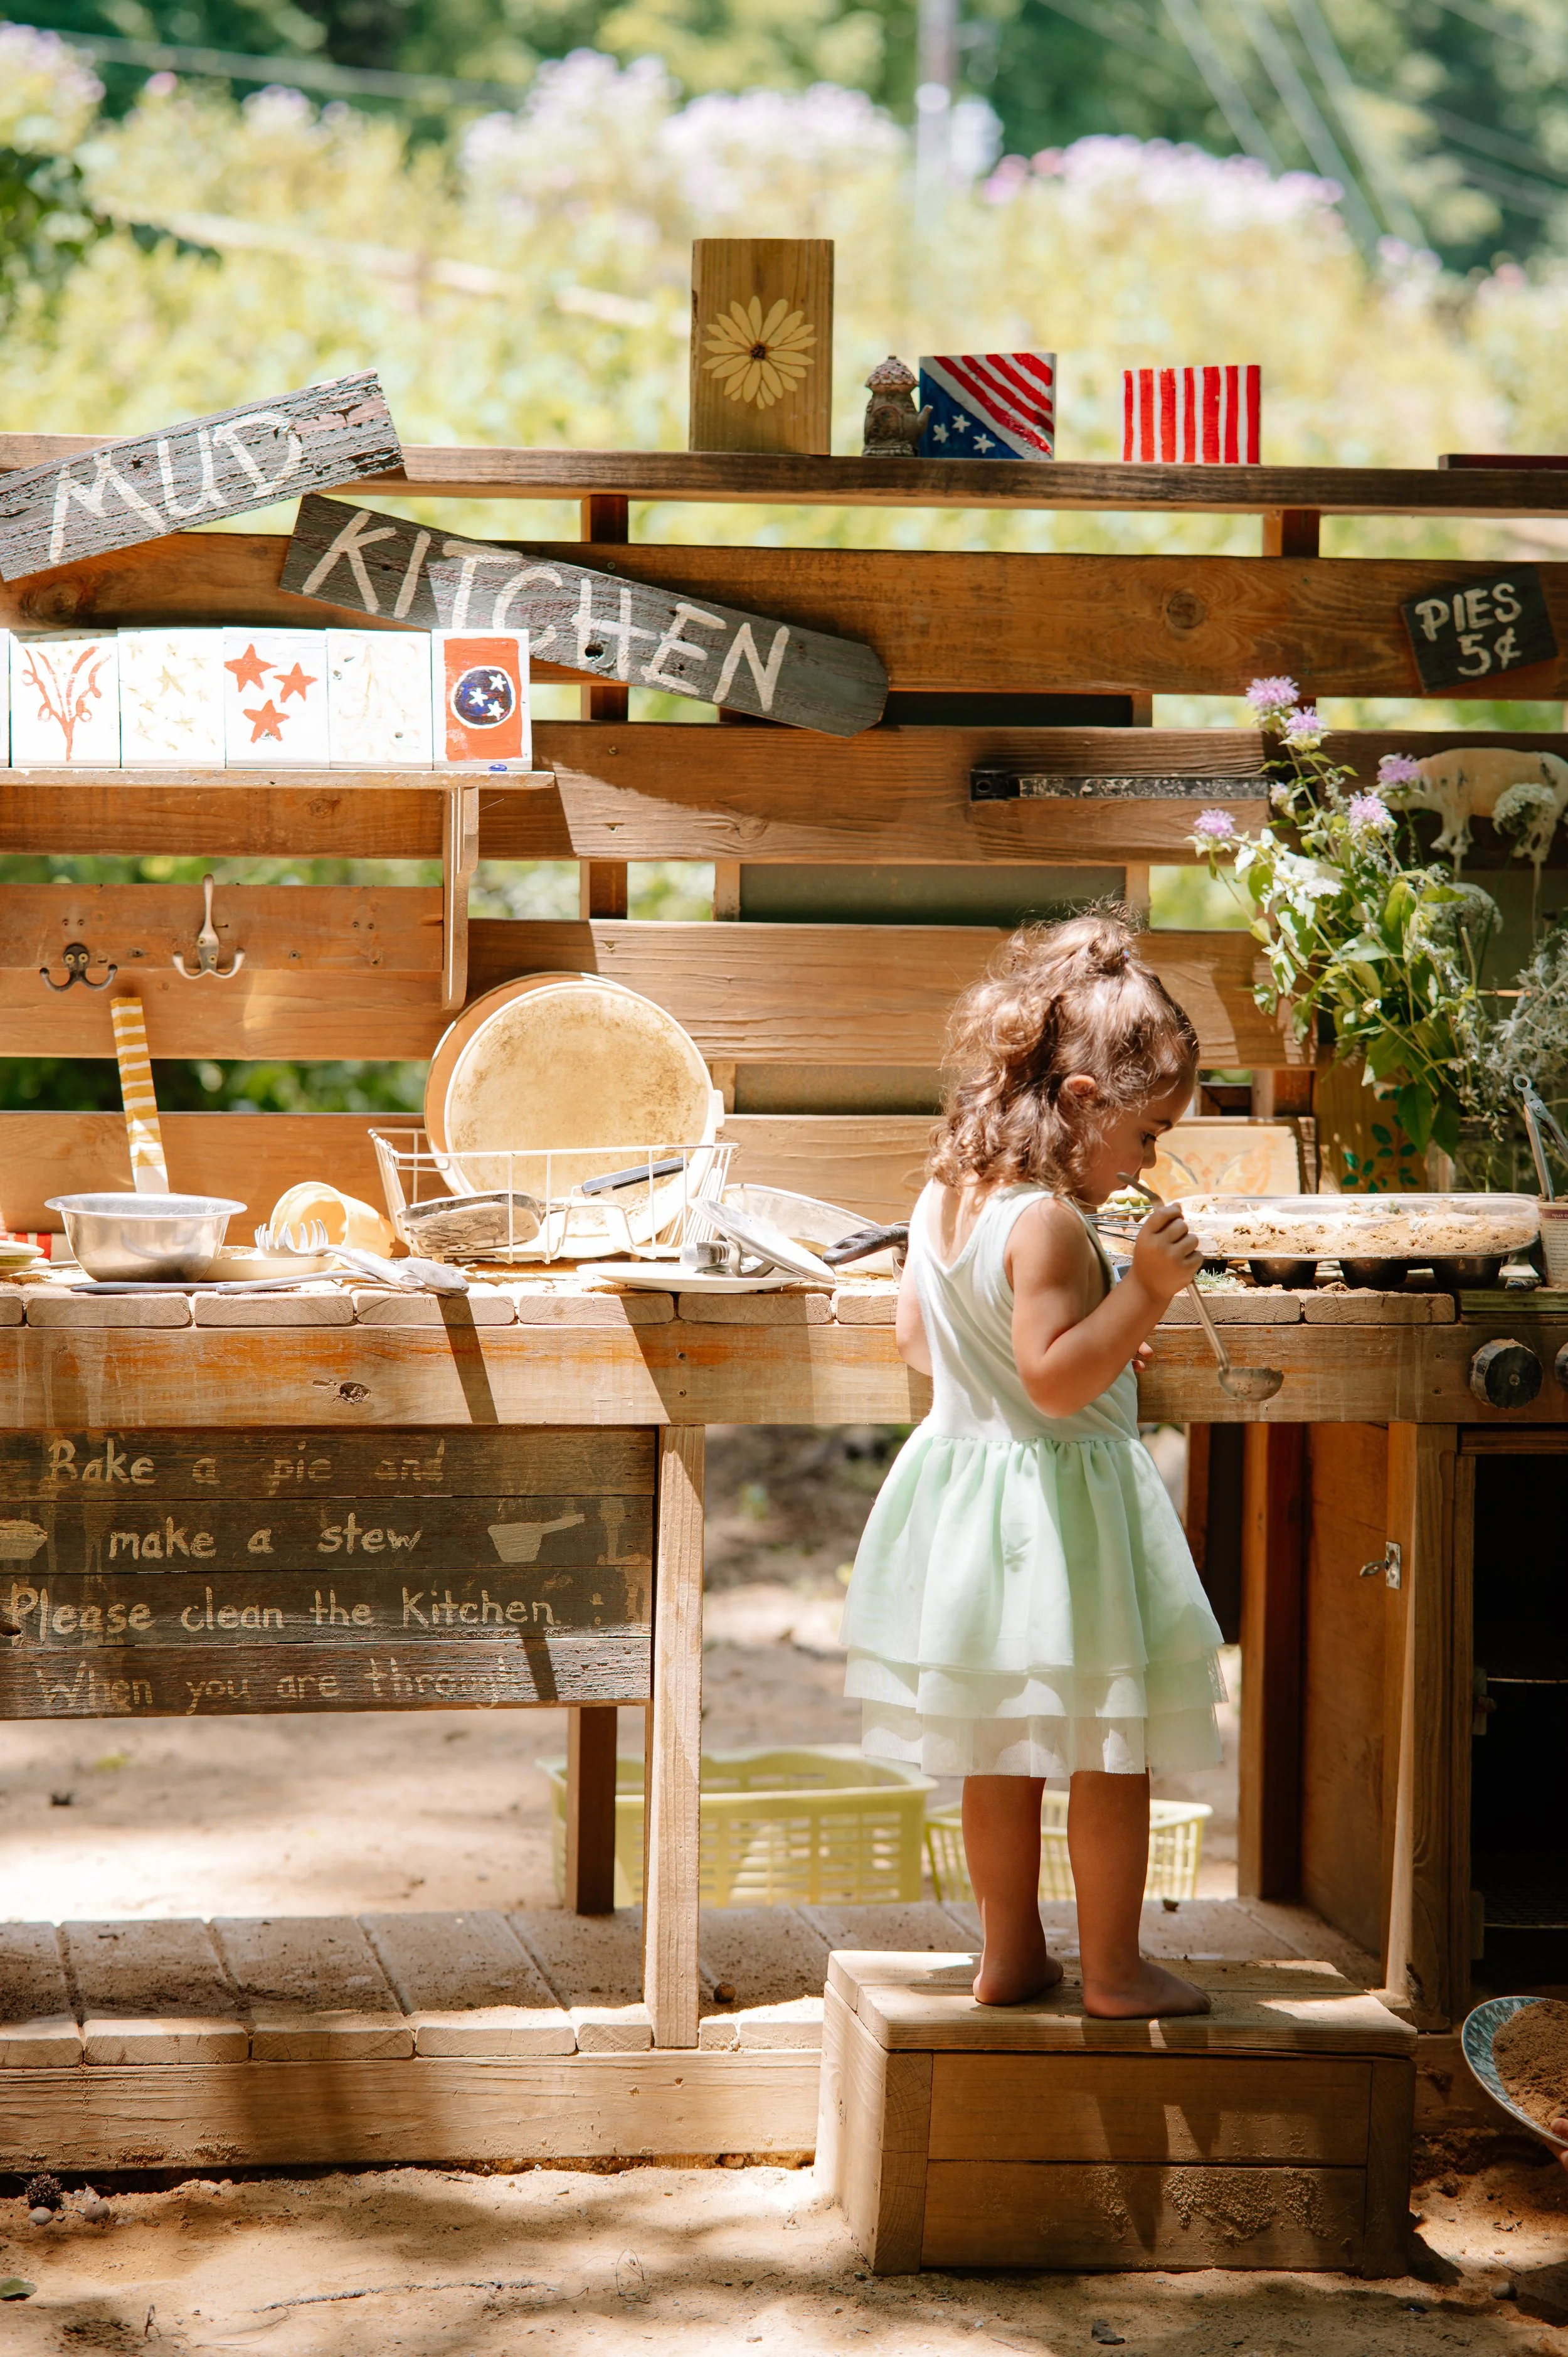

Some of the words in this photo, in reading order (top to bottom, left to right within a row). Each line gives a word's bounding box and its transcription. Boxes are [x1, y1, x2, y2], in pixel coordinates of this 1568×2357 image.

[49, 412, 304, 565] MUD
[301, 510, 792, 711] KITCHEN
[1415, 582, 1522, 642] PIES
[48, 1437, 157, 1484] Bake
[191, 1457, 220, 1484] a
[267, 1440, 332, 1496] pie
[376, 1439, 445, 1482] and
[108, 1516, 216, 1560] make
[247, 1528, 274, 1554] a
[317, 1512, 423, 1555] stew
[1, 1583, 156, 1647] Please
[181, 1586, 284, 1631] clean
[309, 1589, 375, 1626] the
[36, 1660, 152, 1711] When
[186, 1679, 249, 1715] you
[277, 1674, 342, 1700] are
